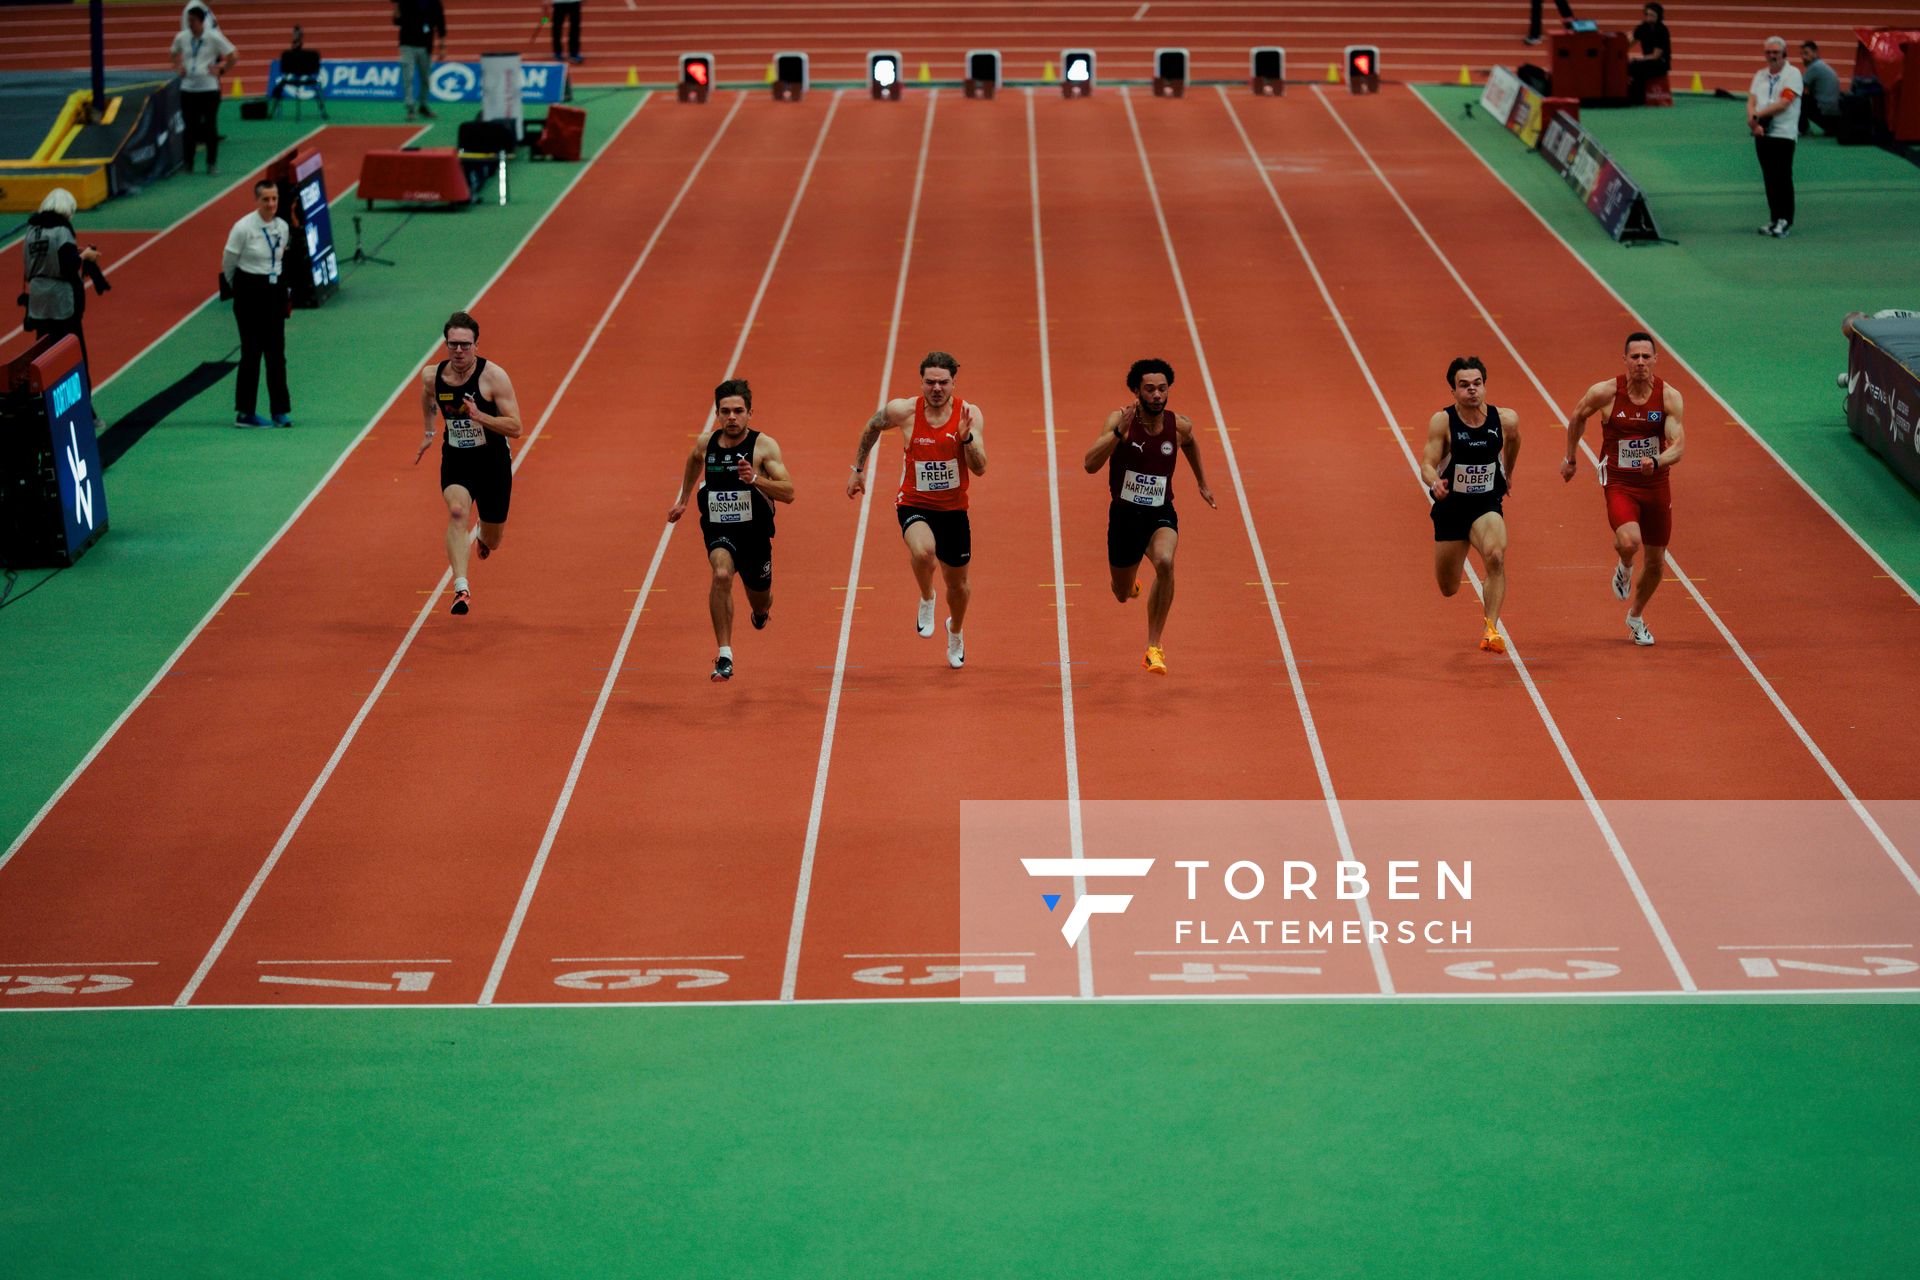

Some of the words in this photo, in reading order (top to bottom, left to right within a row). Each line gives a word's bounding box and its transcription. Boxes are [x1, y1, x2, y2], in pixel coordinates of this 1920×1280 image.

[332, 66, 400, 86] PLAN
[452, 420, 471, 429] GLS
[1629, 439, 1650, 449] GLS
[1621, 446, 1658, 459] STANGENBERG
[925, 461, 947, 471] GLS
[1466, 465, 1488, 475] GLS
[921, 470, 954, 481] FREHE
[1135, 474, 1157, 486] GLS
[1456, 472, 1494, 484] OLBERT
[1125, 480, 1164, 497] HARTMANN
[716, 492, 738, 502] GLS
[709, 501, 750, 513] GUSSMANN
[1150, 962, 1323, 984] 4
[1444, 959, 1621, 981] 3
[1738, 956, 1920, 978] 2
[554, 968, 731, 990] 6
[852, 964, 1026, 985] 5
[259, 971, 436, 992] 7
